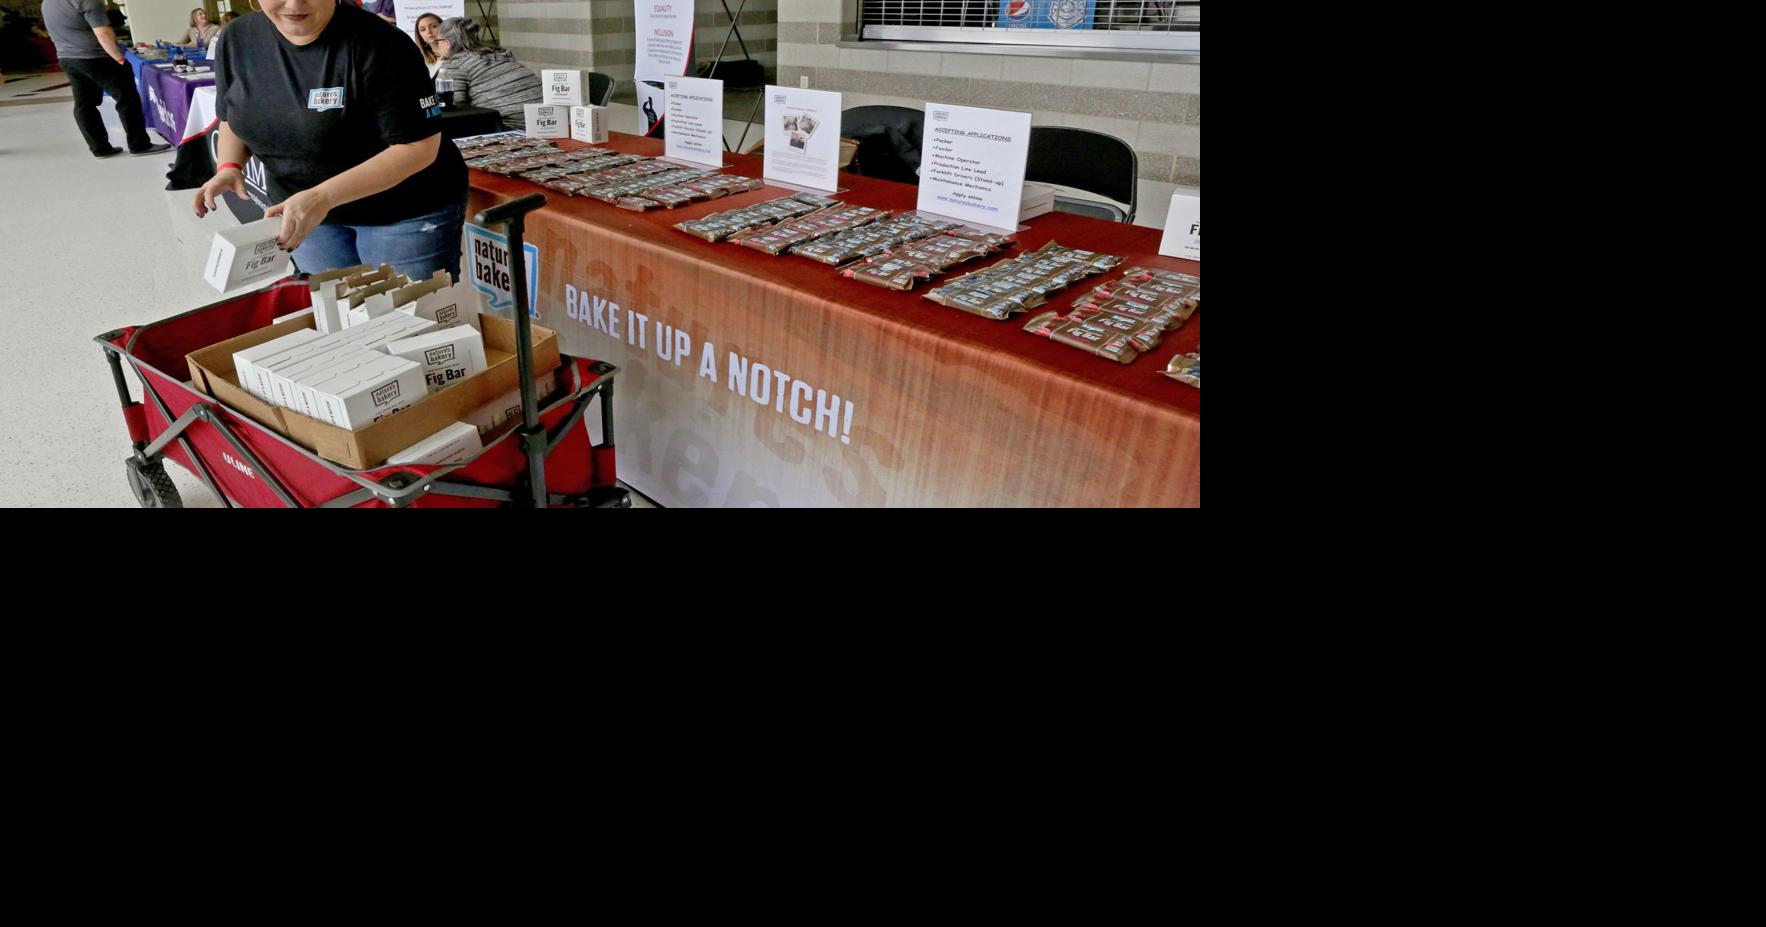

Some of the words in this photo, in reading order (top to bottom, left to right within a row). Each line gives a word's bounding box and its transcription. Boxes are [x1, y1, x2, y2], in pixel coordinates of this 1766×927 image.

[552, 85, 560, 93] Fig
[537, 119, 546, 127] Fig
[935, 127, 966, 136] ACCEPTING
[967, 131, 1012, 142] APPLICATIONS
[475, 238, 508, 267] natur
[245, 260, 259, 271] Fig
[260, 255, 276, 265] Bar
[475, 255, 510, 292] bake
[1082, 331, 1101, 341] Bar
[430, 353, 452, 362] bakery
[565, 283, 621, 340] BAKE
[627, 309, 649, 350] IT
[656, 321, 692, 367] UP
[700, 341, 738, 384] A
[728, 351, 855, 446] NOTCH!
[425, 372, 446, 386] Fig
[445, 367, 466, 381] Bar
[376, 390, 397, 403] bakery
[222, 451, 255, 480] ULINE
